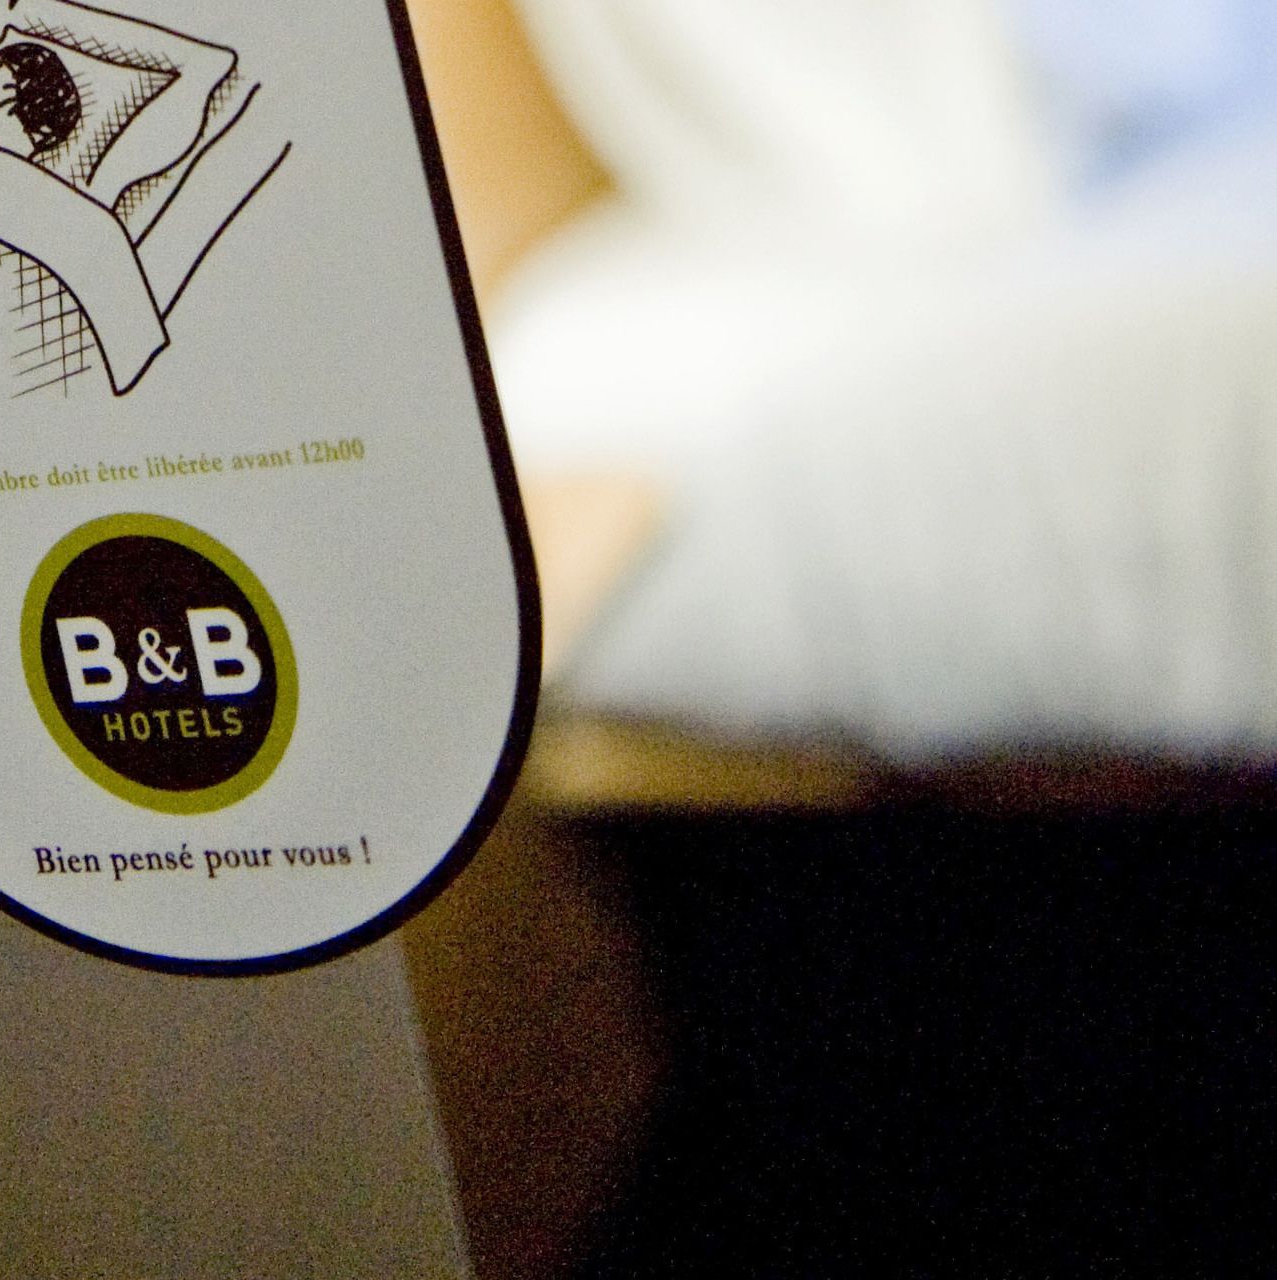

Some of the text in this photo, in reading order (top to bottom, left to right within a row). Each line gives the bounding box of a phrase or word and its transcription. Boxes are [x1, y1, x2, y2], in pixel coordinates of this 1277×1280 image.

[47, 463, 91, 487] doit
[98, 460, 139, 482] être
[145, 451, 223, 479] libérée
[231, 449, 292, 471] avant
[299, 436, 366, 465] 12h00
[55, 606, 263, 704] B&B
[103, 706, 244, 743] HOTELS
[33, 846, 101, 875] Bien
[109, 843, 195, 881] pensé
[202, 846, 273, 879] pour
[282, 843, 352, 868] vous
